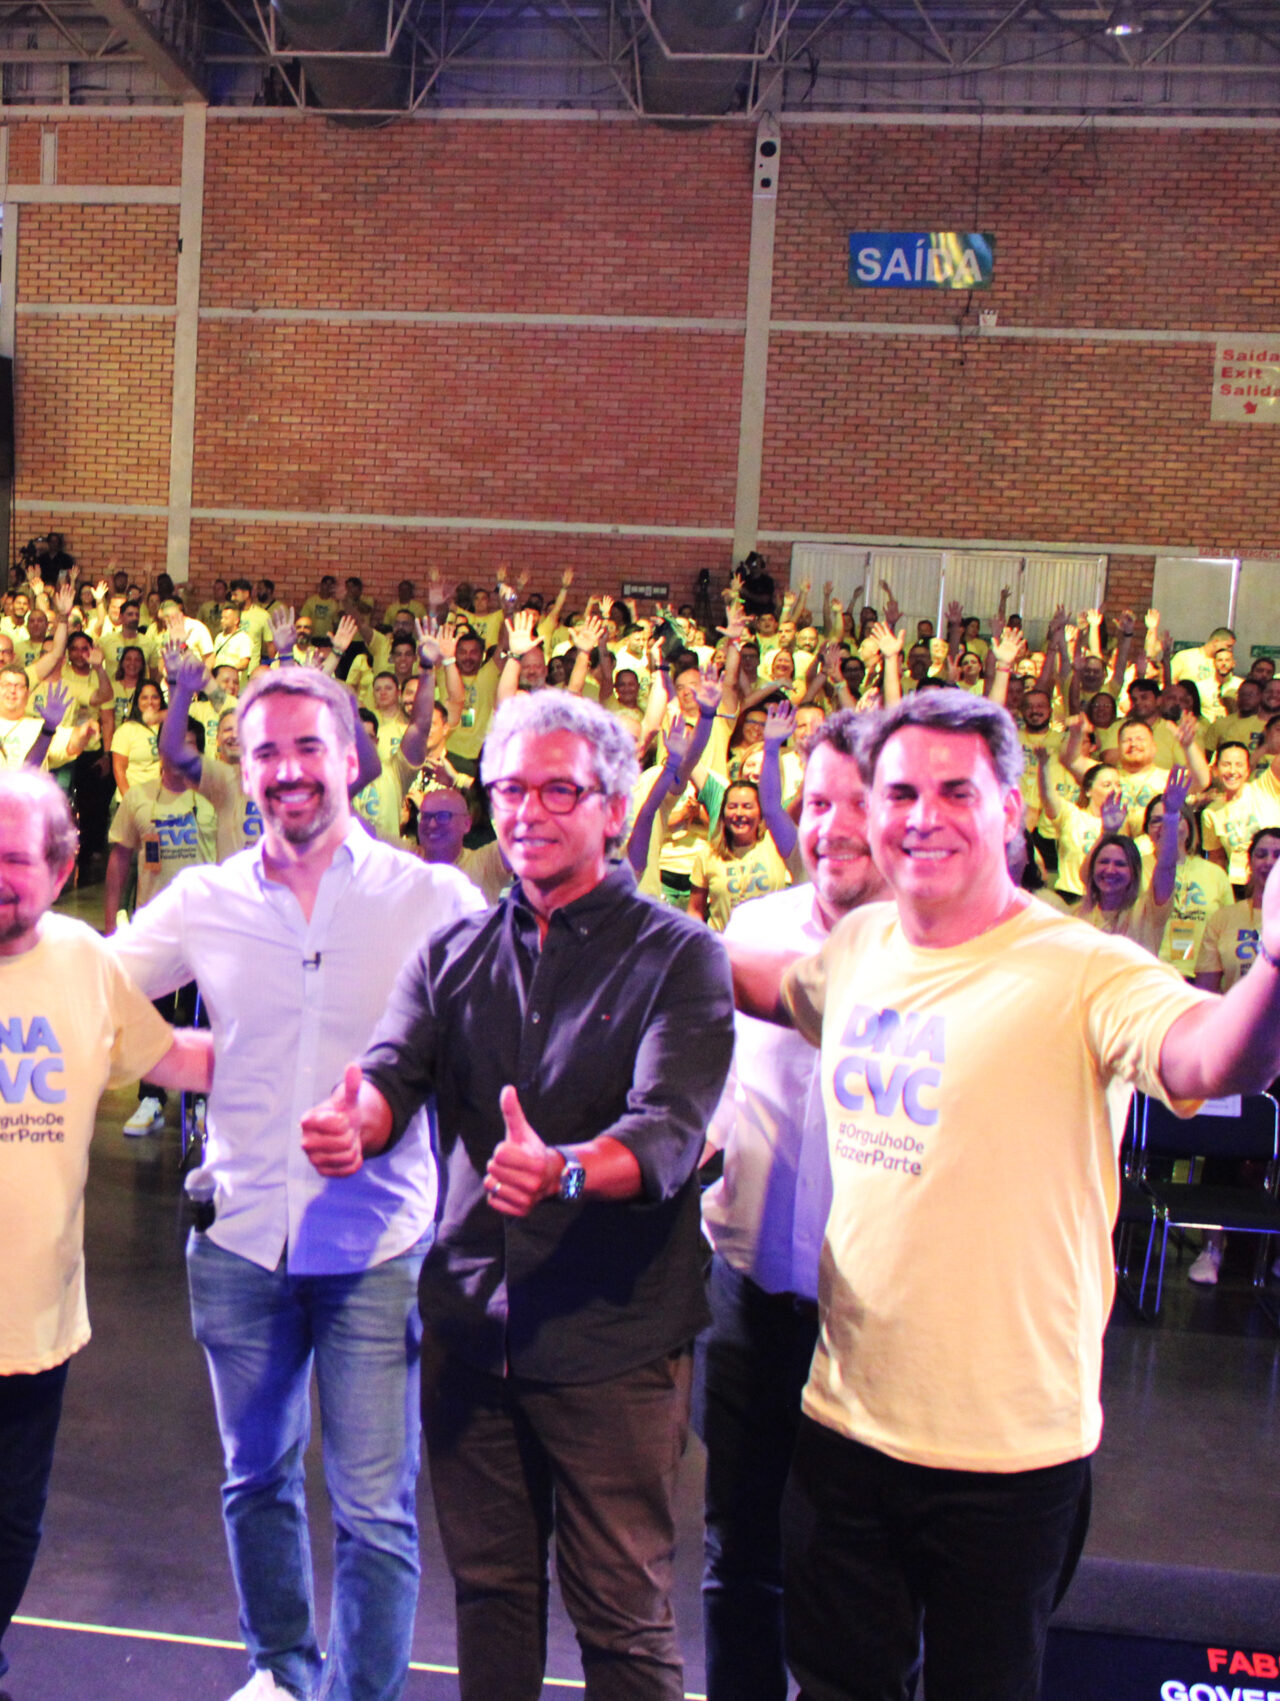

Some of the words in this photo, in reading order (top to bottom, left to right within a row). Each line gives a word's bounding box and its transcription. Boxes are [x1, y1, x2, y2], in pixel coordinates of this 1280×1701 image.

[856, 239, 983, 282] SAÍDA
[1221, 367, 1262, 379] Exit
[840, 1004, 946, 1064] DNA
[833, 1055, 942, 1126] CVC
[835, 1138, 923, 1177] FazerParte
[838, 1121, 926, 1155] #OrgulhoDe
[1207, 1647, 1280, 1679] FAB
